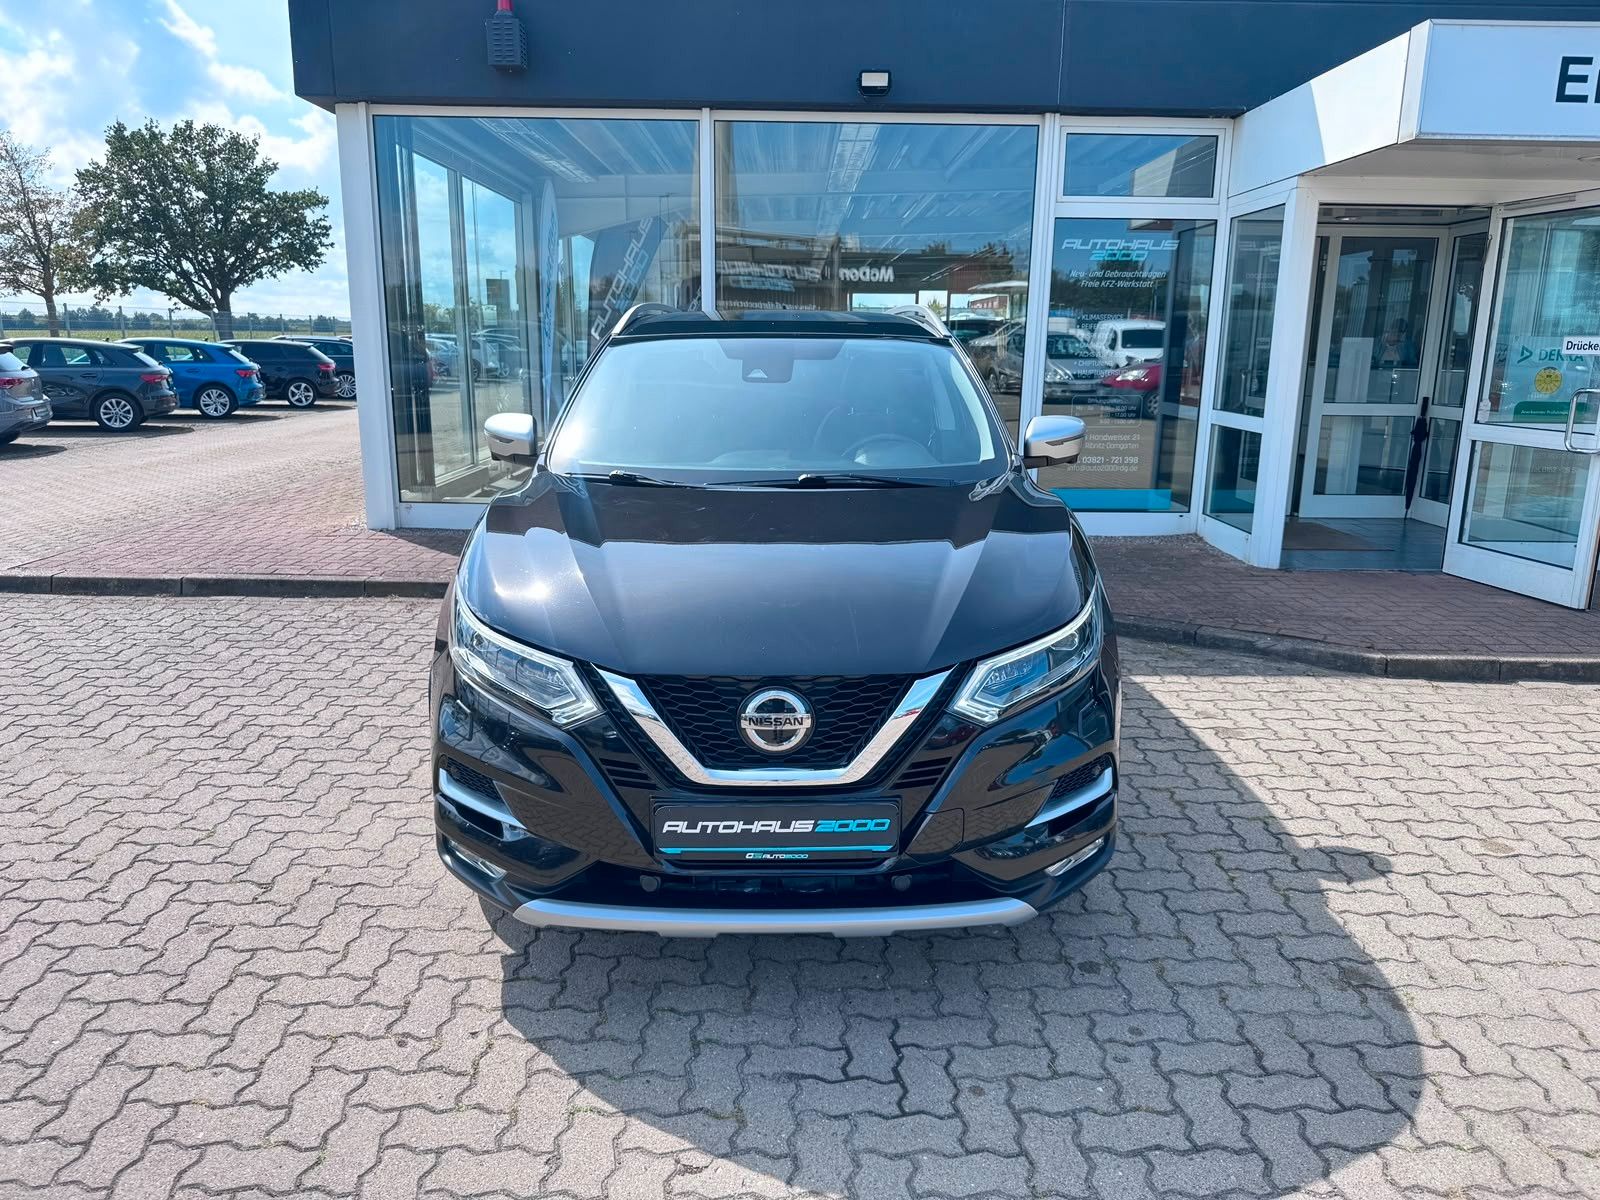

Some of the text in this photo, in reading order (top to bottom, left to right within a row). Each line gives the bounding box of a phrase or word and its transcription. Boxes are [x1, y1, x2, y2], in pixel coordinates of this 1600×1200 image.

[1555, 56, 1600, 104] E
[1061, 238, 1180, 250] AUTOHAUS
[1089, 250, 1149, 261] 2000
[1070, 270, 1166, 280] Neu- und Gebrauchtwagen
[1081, 280, 1154, 288] Freie KFZ-Werkstatt
[1566, 341, 1600, 351] Drücke
[1082, 456, 1105, 464] 03821
[1110, 456, 1123, 464] 721
[1124, 456, 1139, 464] 398
[748, 716, 804, 727] NISSAN
